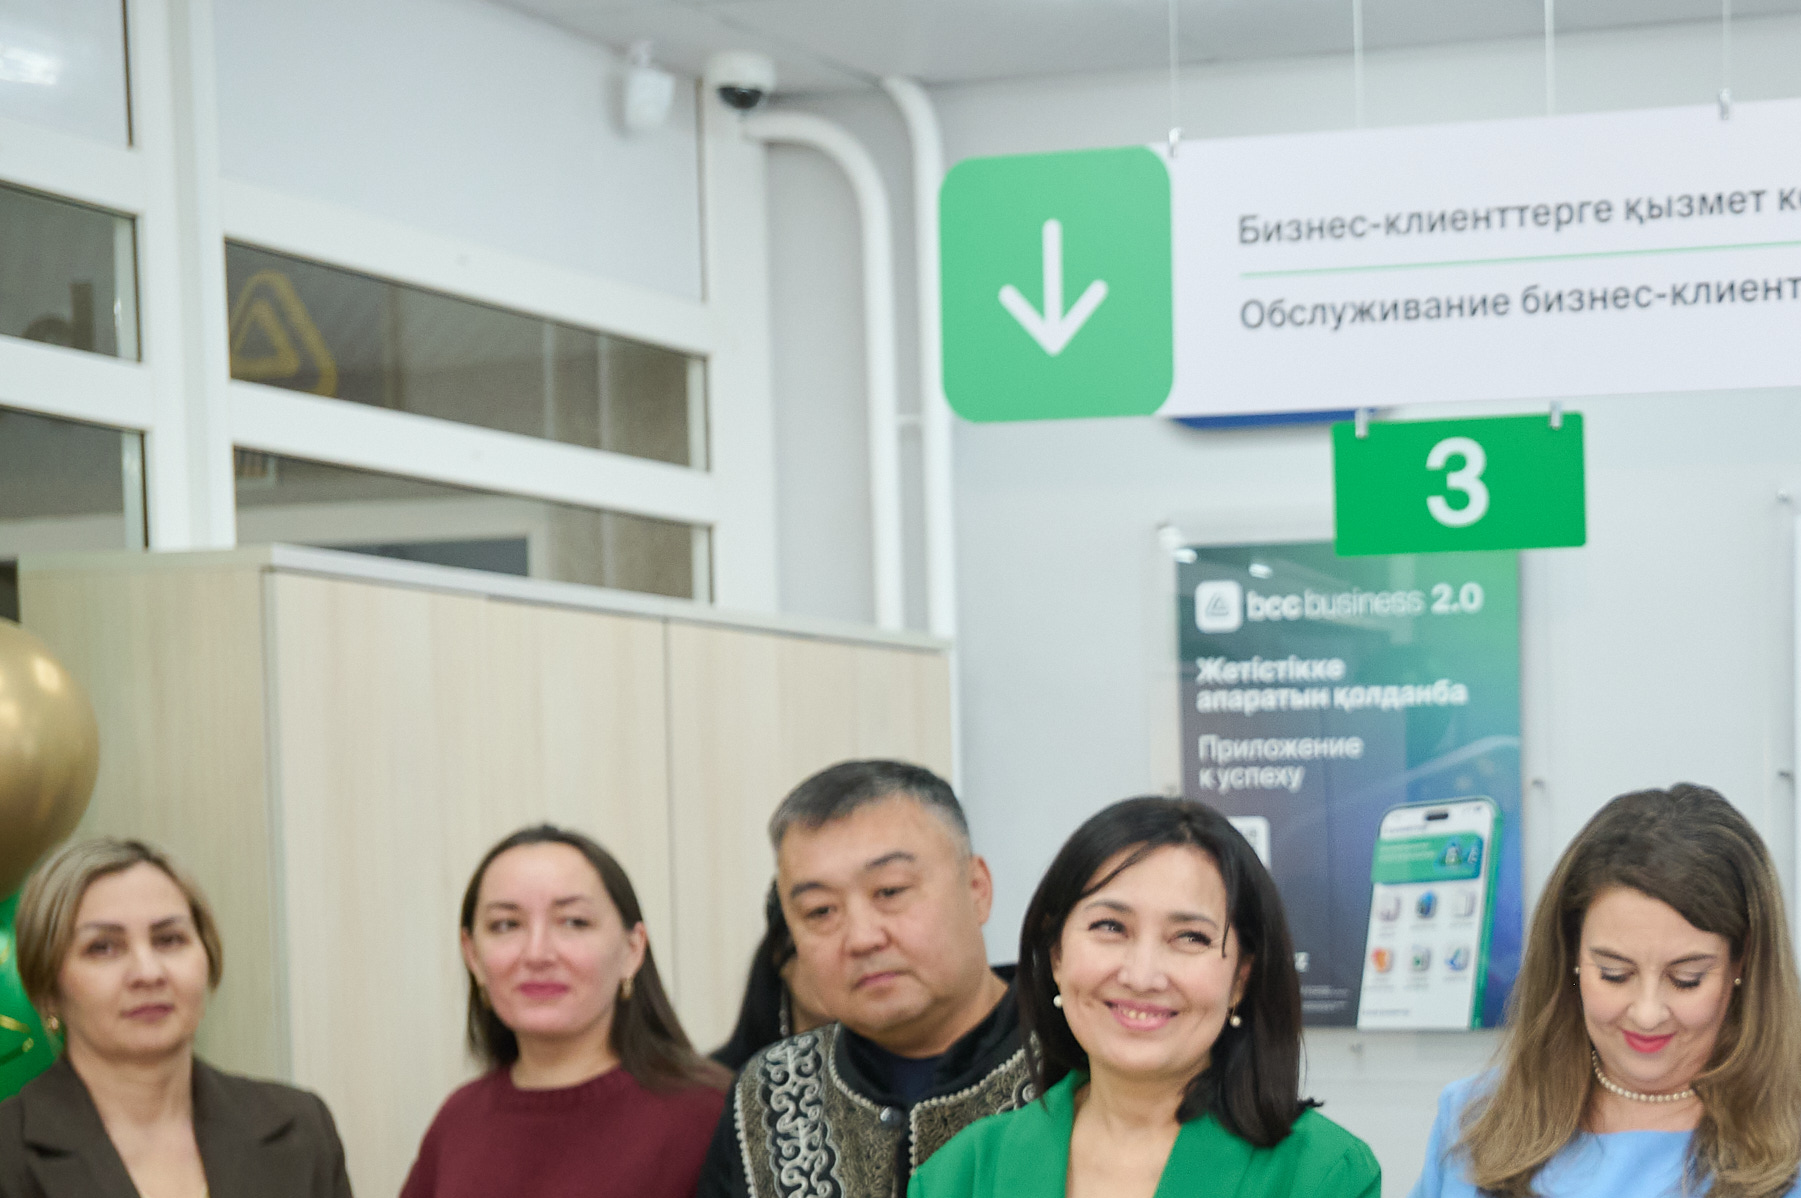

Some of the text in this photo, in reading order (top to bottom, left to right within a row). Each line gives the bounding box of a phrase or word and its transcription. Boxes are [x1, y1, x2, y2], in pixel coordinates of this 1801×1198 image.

[1238, 198, 1613, 245] Бизнес-клиенттерге
[1624, 188, 1766, 225] қызмет
[1240, 291, 1511, 332] Обслуживание
[1425, 436, 1490, 528] 3
[1303, 586, 1427, 620] business
[1430, 581, 1485, 614] 2.0
[1199, 733, 1365, 765] Приложение
[1217, 766, 1306, 794] успеху
